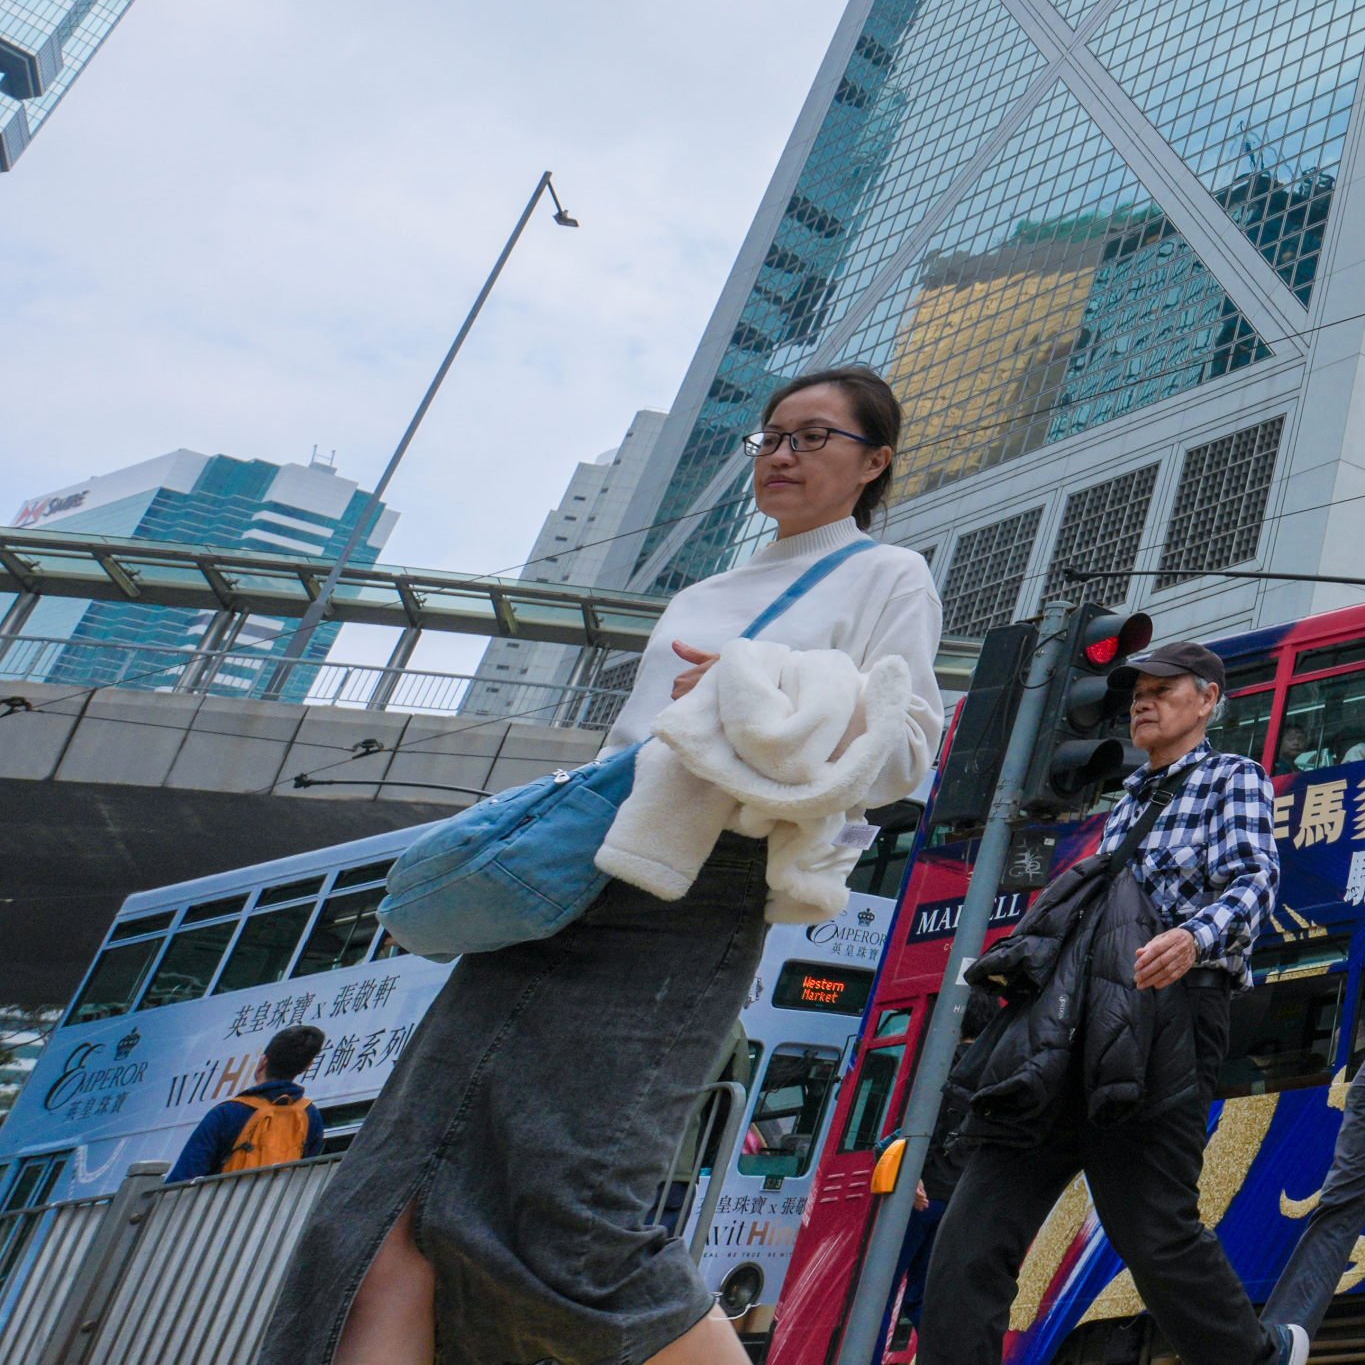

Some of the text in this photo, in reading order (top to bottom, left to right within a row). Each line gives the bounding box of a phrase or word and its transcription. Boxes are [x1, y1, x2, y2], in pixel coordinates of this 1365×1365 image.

[915, 893, 1021, 935] MALL
[831, 941, 880, 961] 英皇珠寶
[801, 988, 839, 1003] Market
[802, 976, 845, 992] Western
[223, 991, 316, 1041] 英皇珠寶
[329, 975, 400, 1019] 張敬軒
[44, 1042, 149, 1110] EMPEROR
